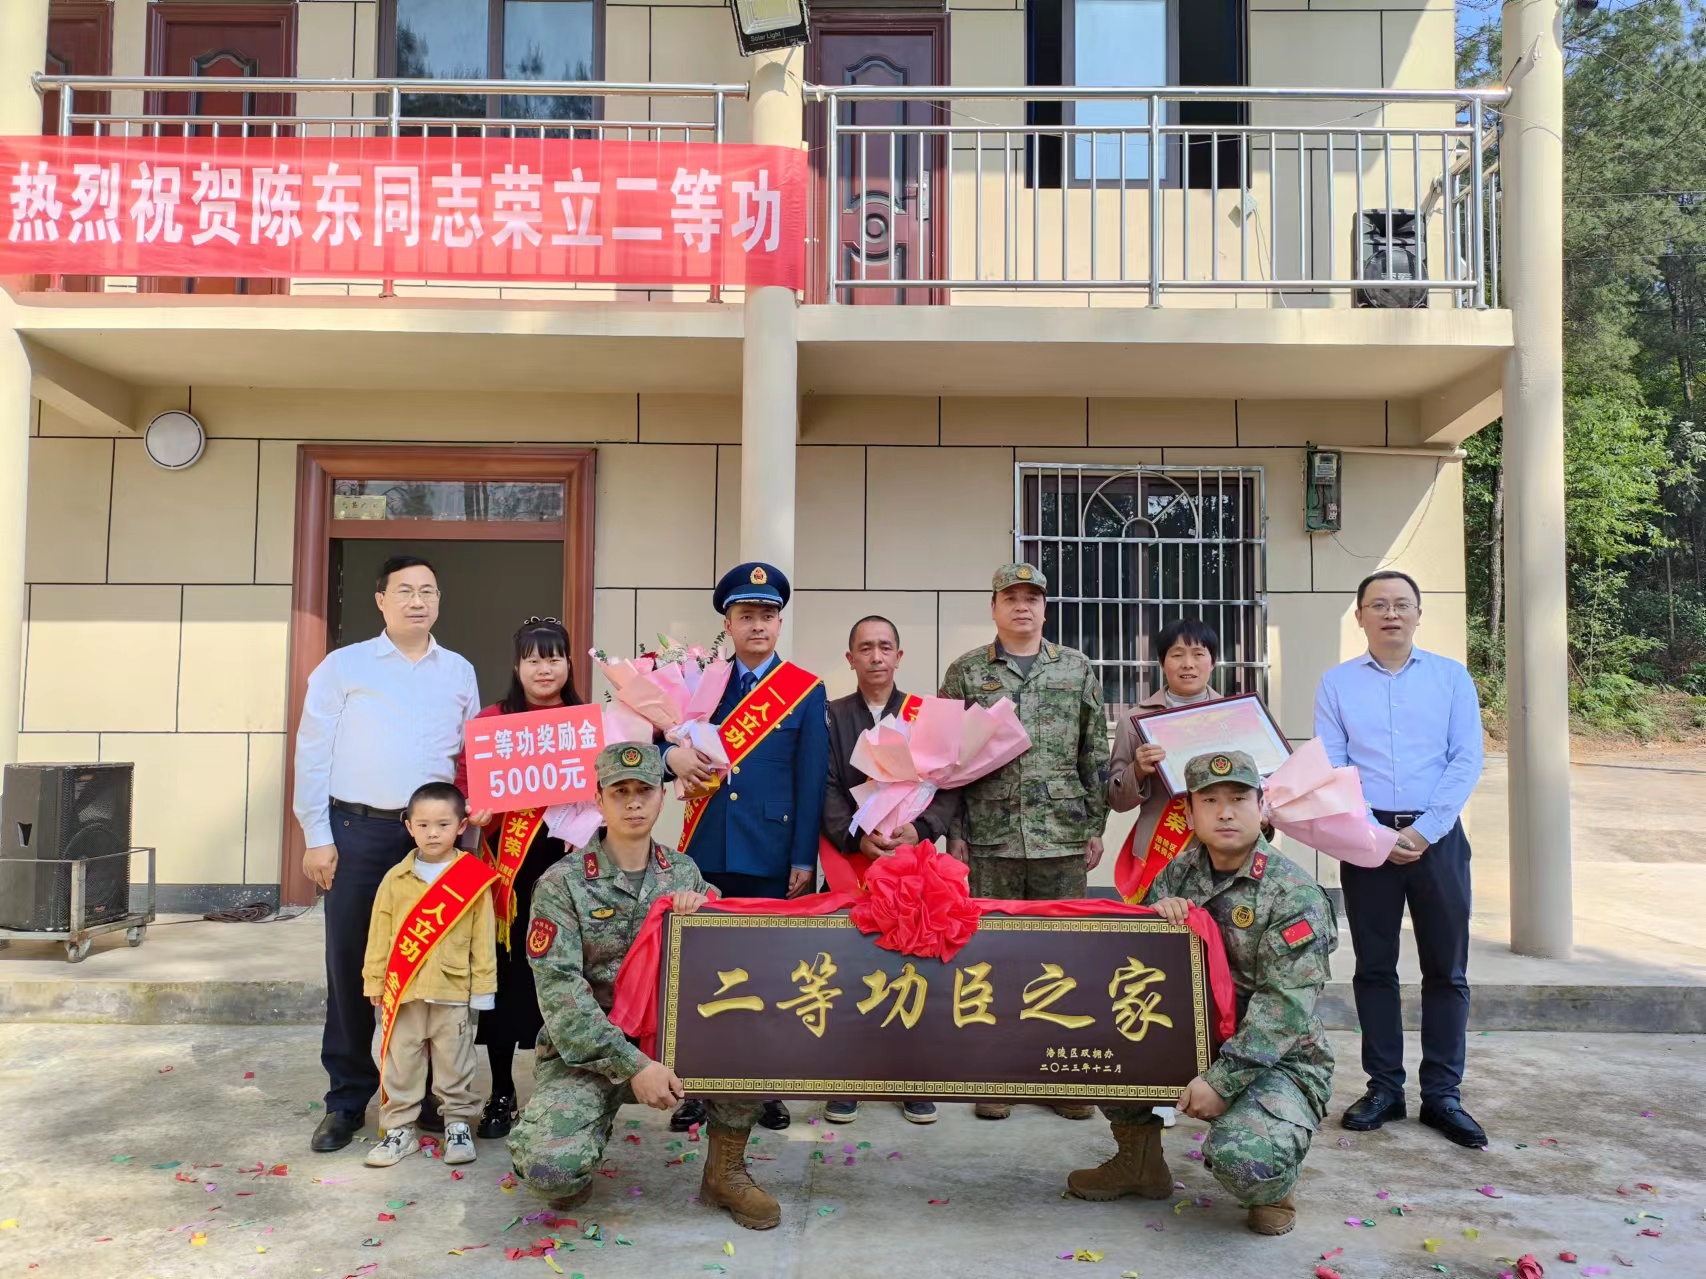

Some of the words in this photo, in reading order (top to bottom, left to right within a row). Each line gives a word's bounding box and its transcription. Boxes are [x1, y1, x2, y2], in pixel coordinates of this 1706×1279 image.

[766, 31, 781, 40] Light
[9, 162, 782, 253] 热烈祝贺陈东同志荣立二等功
[474, 719, 598, 760] 二等功奖励金
[724, 686, 787, 749] 一人立功
[490, 757, 587, 798] 5000元
[398, 884, 465, 963] 一人立功
[697, 952, 1174, 1042] 二等功臣之家
[1046, 1046, 1114, 1059] 涪陵区双拥办
